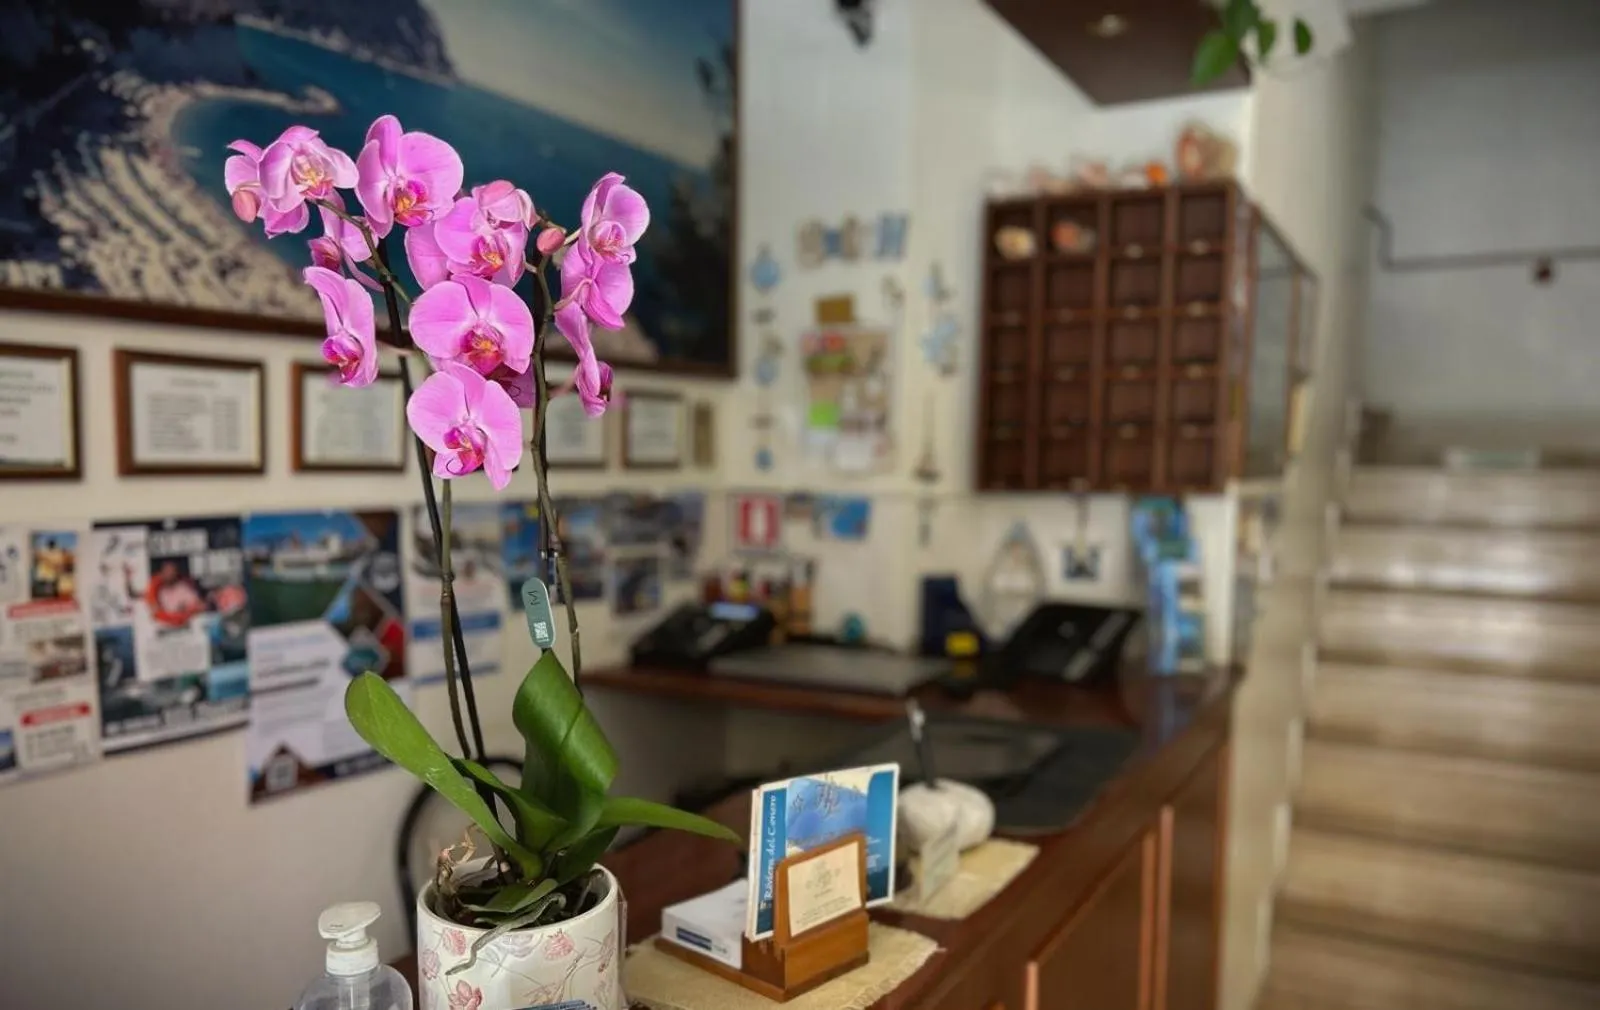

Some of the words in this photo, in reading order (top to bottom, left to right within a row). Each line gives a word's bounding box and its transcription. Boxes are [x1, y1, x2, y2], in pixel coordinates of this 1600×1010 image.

[767, 794, 777, 836] Conero
[766, 839, 776, 855] del
[764, 859, 775, 899] Riviera
